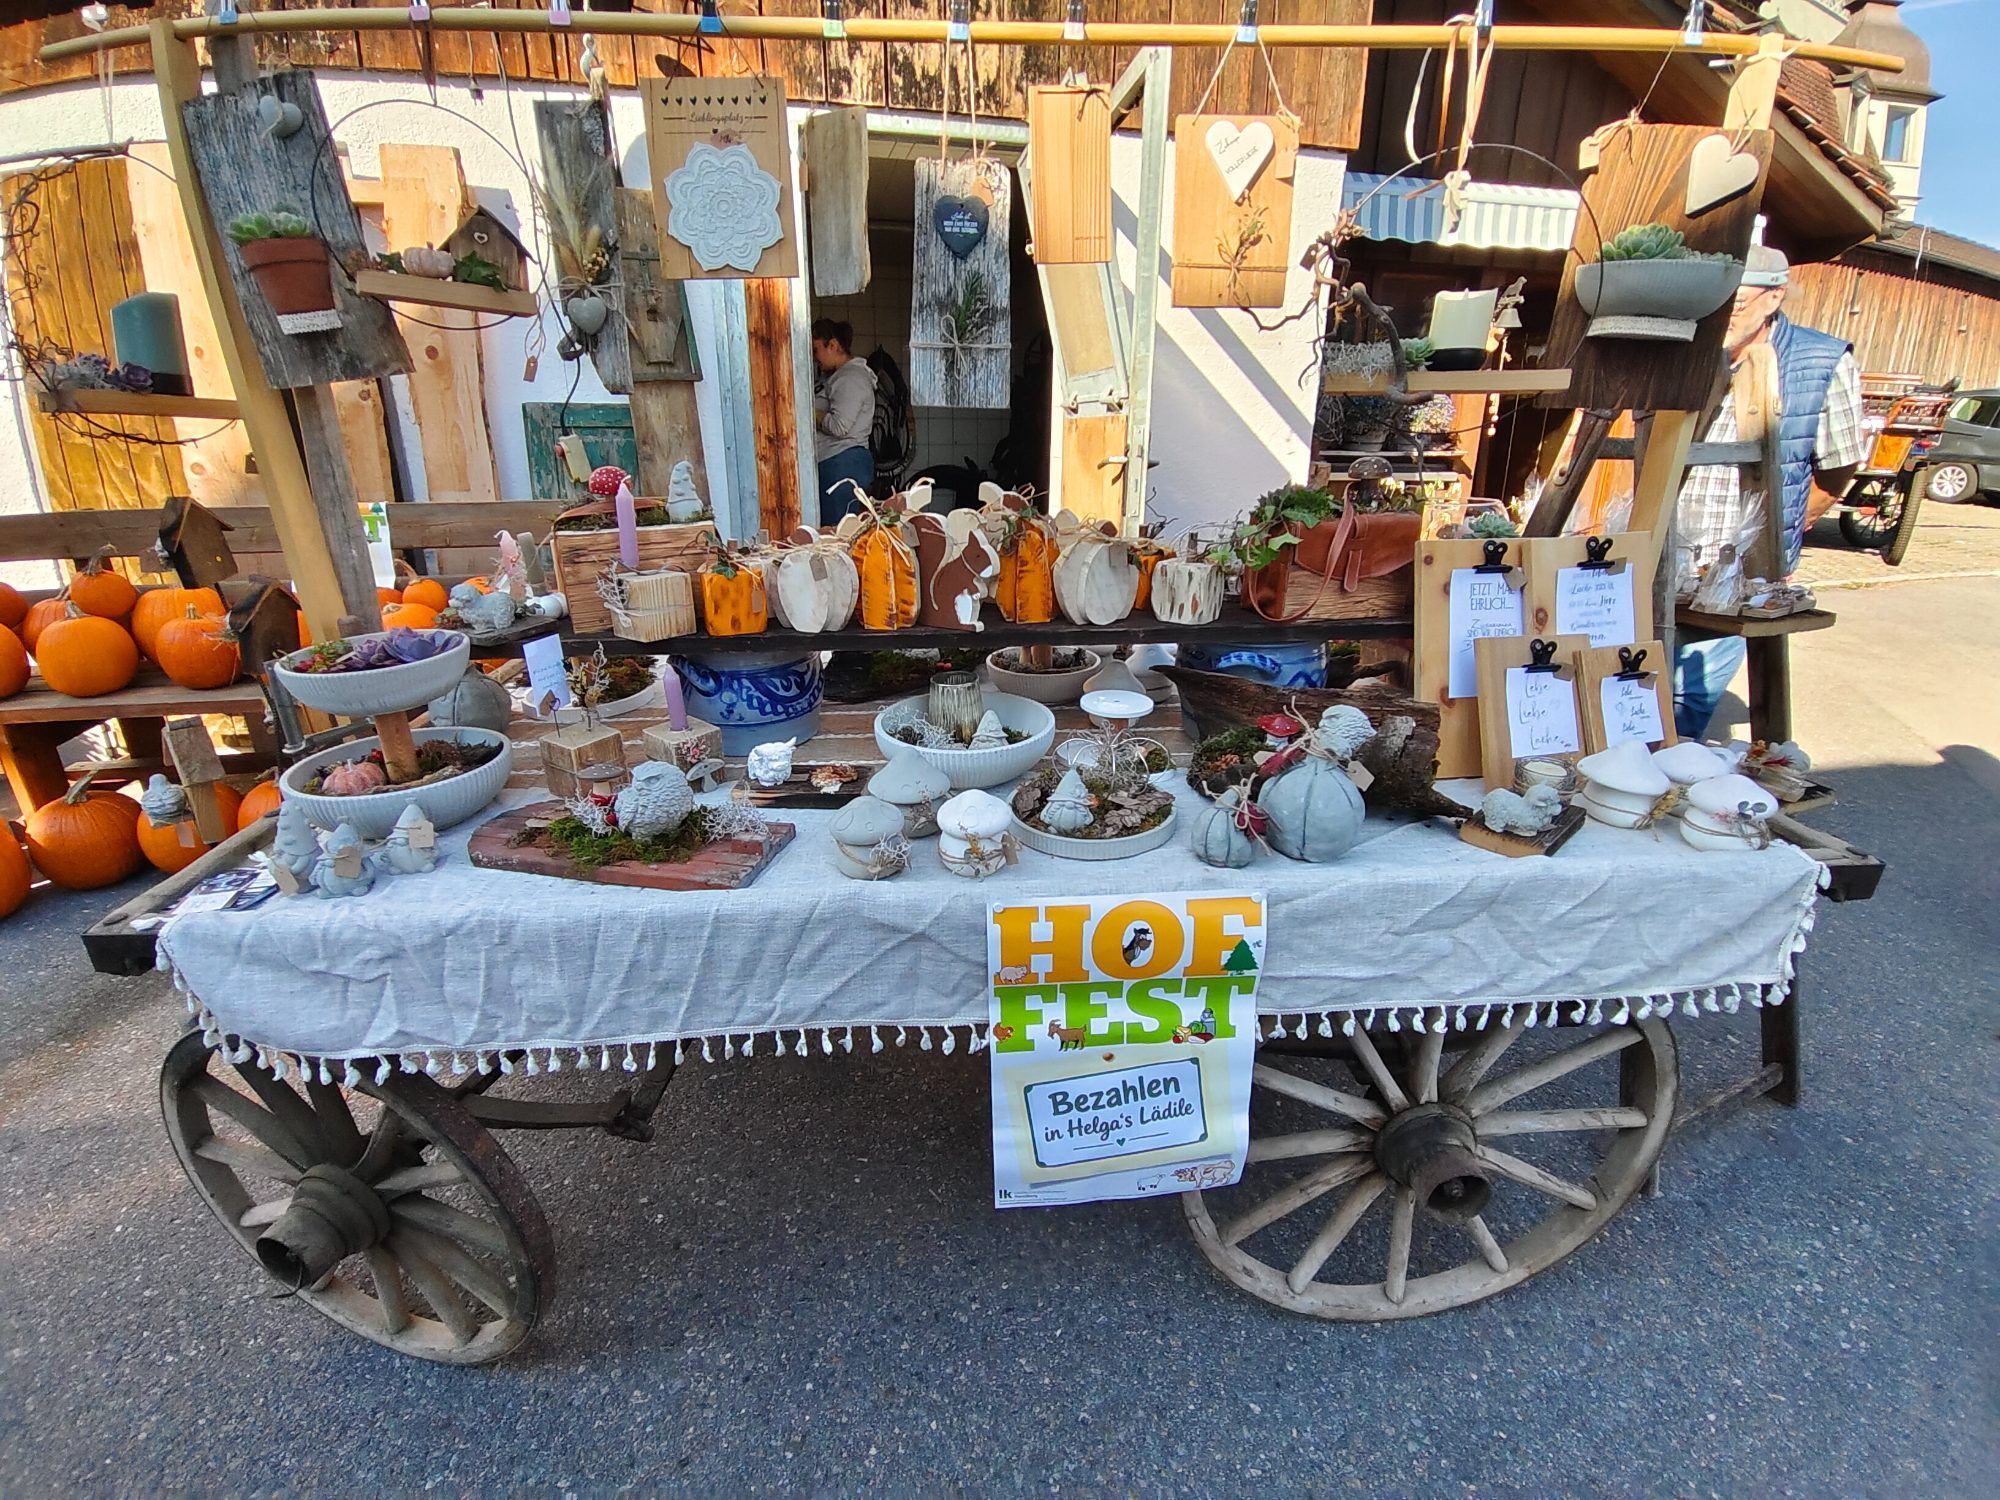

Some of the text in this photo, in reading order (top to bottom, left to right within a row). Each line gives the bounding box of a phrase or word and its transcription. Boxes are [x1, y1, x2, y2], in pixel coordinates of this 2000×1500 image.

[1469, 583, 1493, 599] JETZT
[993, 896, 1262, 985] HOF
[993, 975, 1257, 1053] FEST
[1048, 1075, 1181, 1116] Bezahlen
[1044, 1127, 1064, 1142] in
[1139, 1098, 1195, 1125] Lädile
